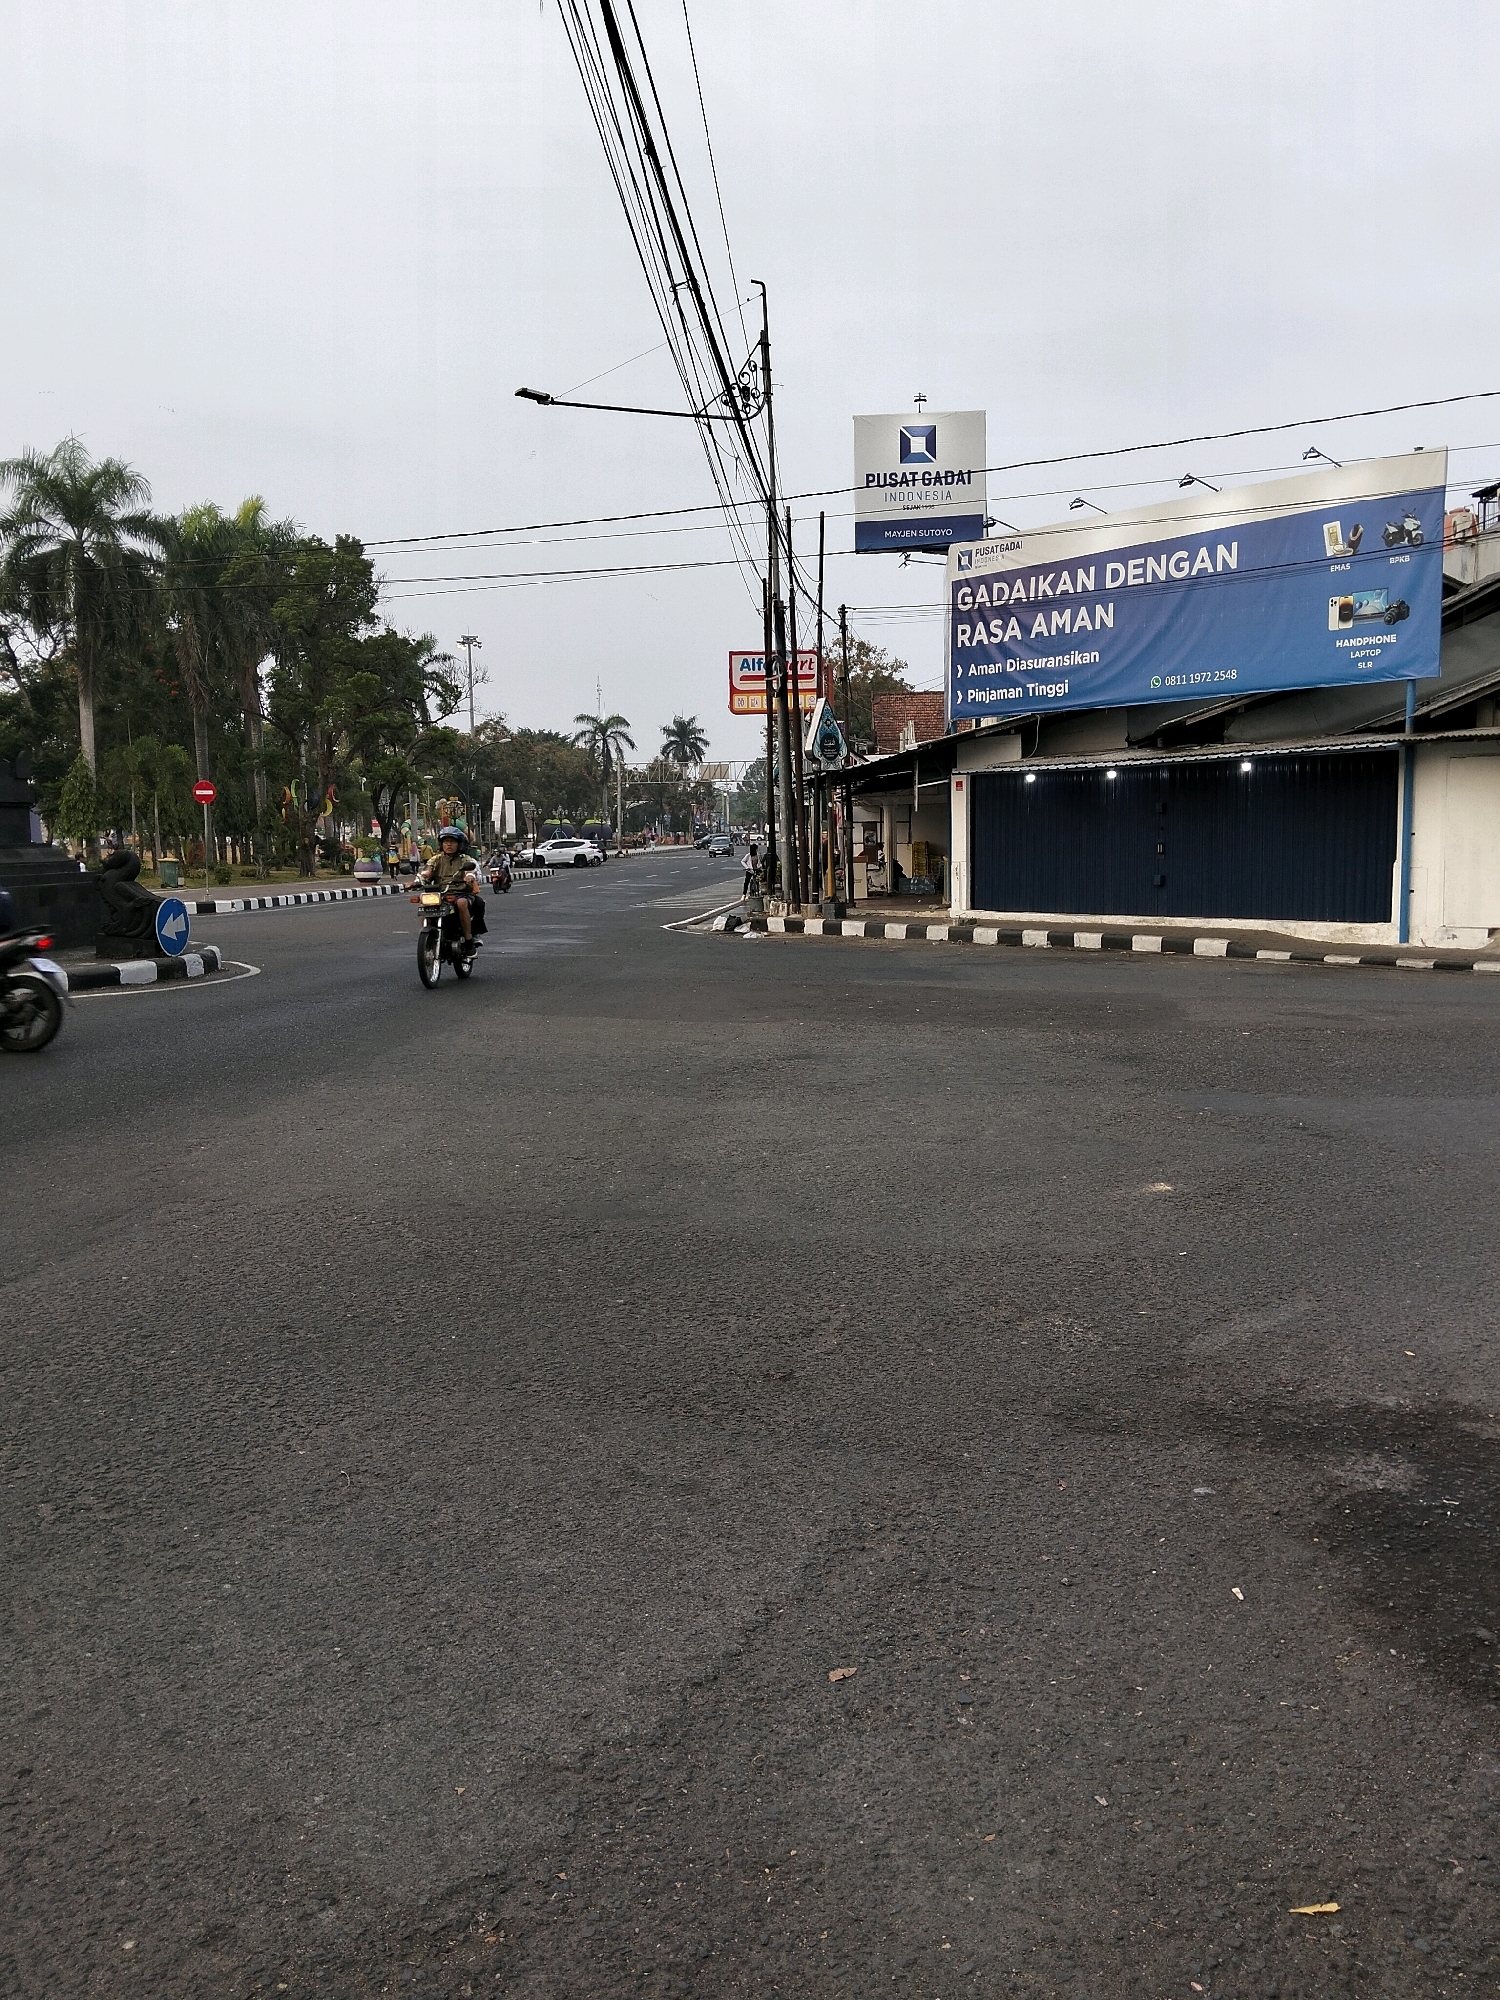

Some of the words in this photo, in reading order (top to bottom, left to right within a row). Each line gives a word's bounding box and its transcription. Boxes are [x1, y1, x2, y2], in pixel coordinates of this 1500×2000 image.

[865, 471, 918, 488] PUSAT
[922, 469, 972, 486] GADAI
[884, 490, 953, 503] INDONESIA
[884, 530, 917, 538] MAYJEN
[918, 528, 953, 537] SUTOYO
[975, 544, 999, 557] PUSAT
[1000, 541, 1023, 553] GADAI
[1389, 555, 1410, 564] BPKB
[1330, 563, 1351, 572] EMAS
[957, 566, 1095, 611] GADAIKAN
[1105, 541, 1239, 590] DENGAN
[957, 617, 1022, 648] RASA
[1030, 602, 1114, 639] AMAN
[1336, 634, 1397, 648] HANDPHONE
[1350, 648, 1381, 659] LAPTOP
[968, 663, 1002, 677] Aman
[1006, 650, 1100, 672] Diasuransikan
[1357, 661, 1373, 669] SLR
[1165, 674, 1187, 686] 0811
[1189, 671, 1212, 684] 1972
[1213, 669, 1237, 681] 2548
[967, 686, 1023, 703] Pinjaman
[1026, 679, 1069, 698] Tinggi
